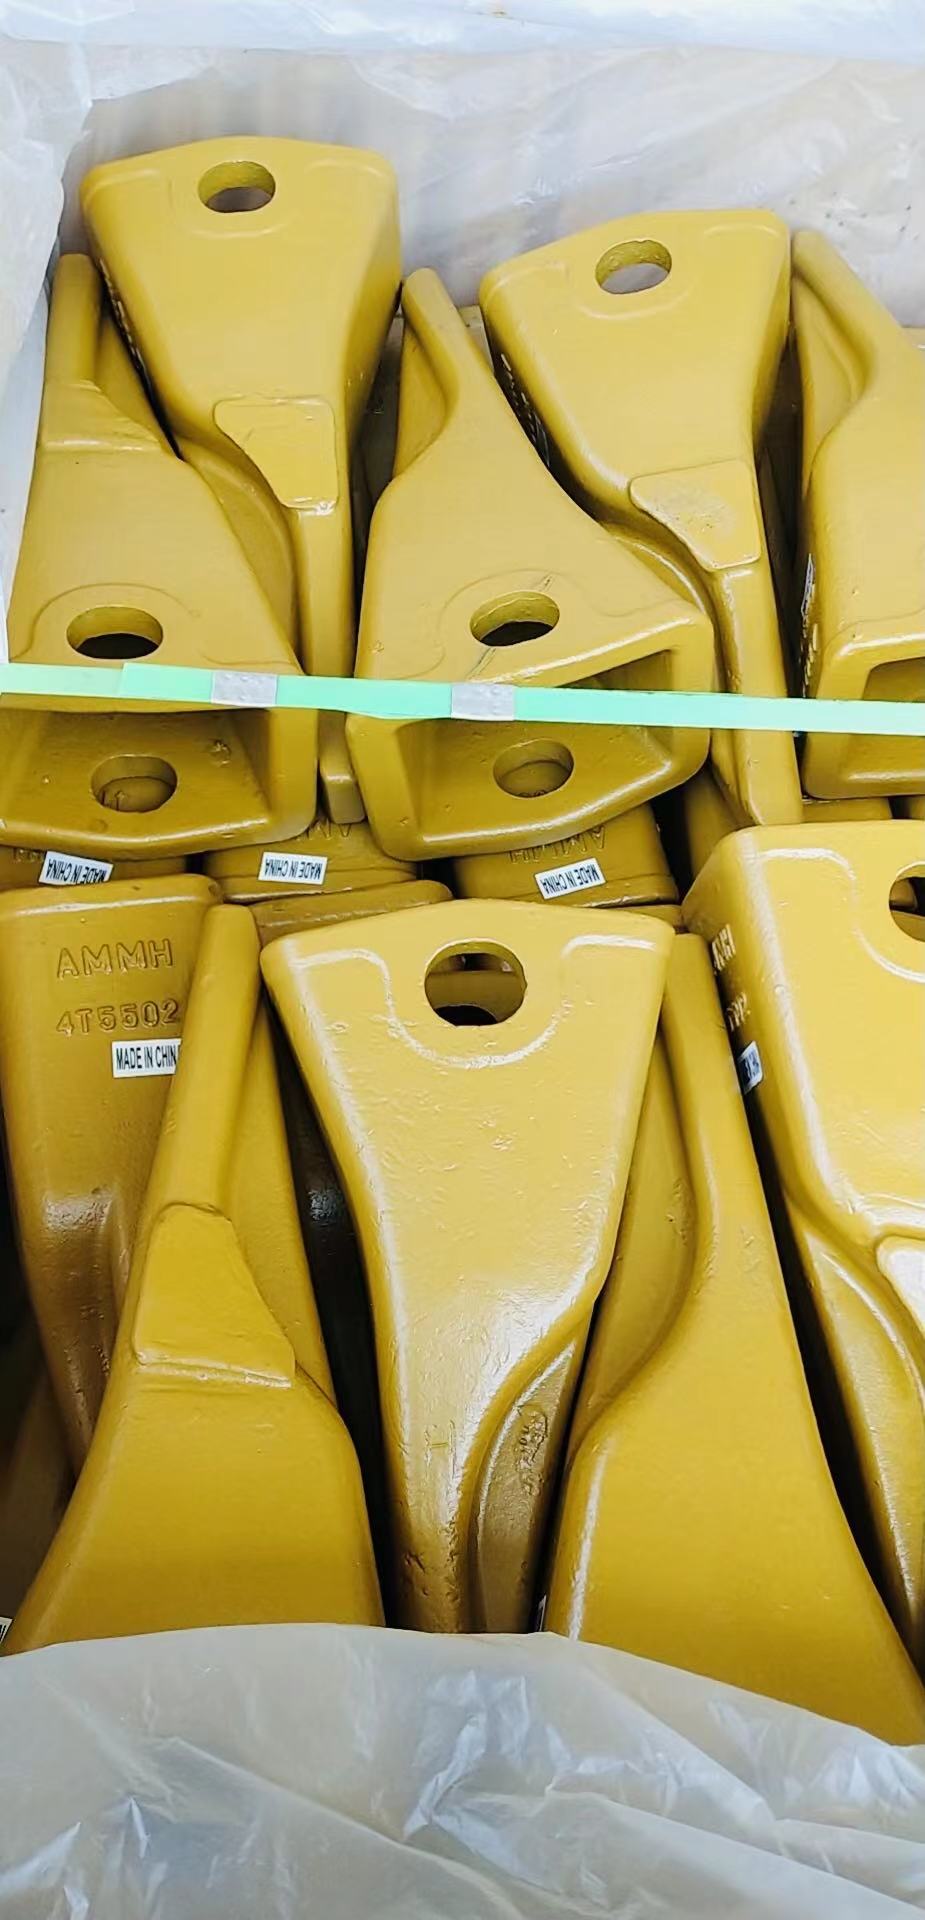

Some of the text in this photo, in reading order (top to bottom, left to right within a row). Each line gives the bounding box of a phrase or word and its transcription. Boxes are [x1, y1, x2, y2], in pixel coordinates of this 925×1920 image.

[45, 859, 72, 882] CHINA
[71, 864, 82, 883] IN
[264, 859, 323, 880] MADE IN CHINA
[540, 864, 601, 895] MADE IN CHINA
[56, 938, 174, 980] AMMH
[56, 998, 181, 1037] 4T5502
[116, 1047, 142, 1070] MADE
[144, 1046, 154, 1068] IN
